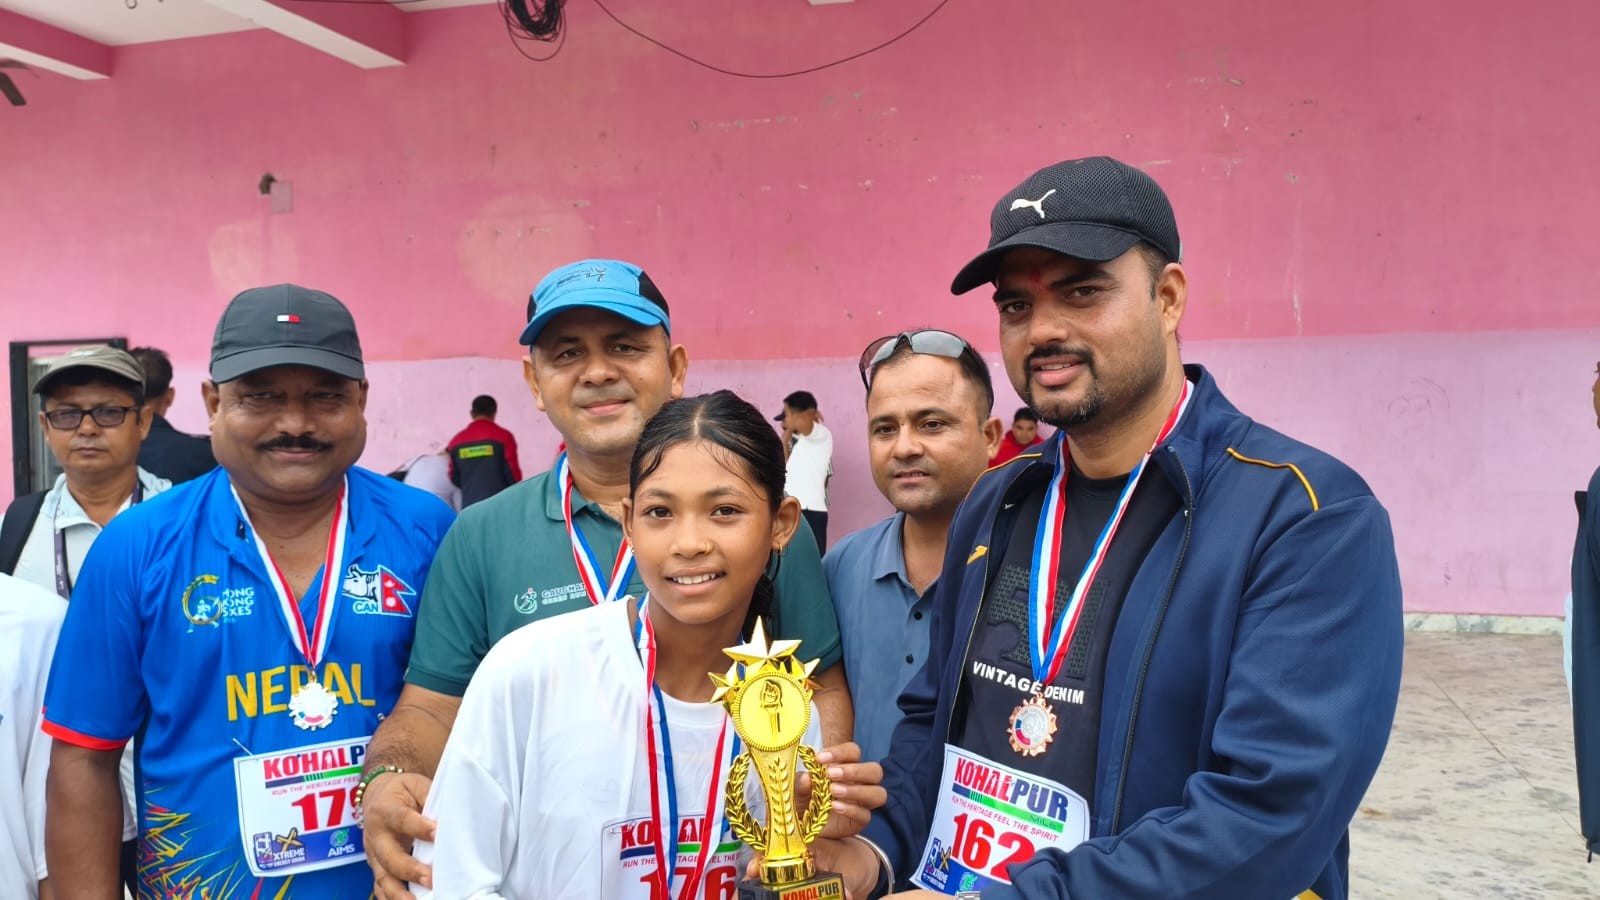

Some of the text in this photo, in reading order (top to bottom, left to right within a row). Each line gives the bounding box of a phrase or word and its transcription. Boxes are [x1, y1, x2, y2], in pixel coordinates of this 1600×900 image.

[222, 597, 254, 607] KONG
[354, 601, 379, 613] CAN
[972, 661, 1085, 705] VINTAGE DENIM
[263, 744, 369, 780] KOHALP
[290, 785, 303, 793] THE
[954, 757, 1068, 822] KOHALPUR
[967, 802, 992, 818] HERITAGE
[993, 812, 1010, 826] FEEL
[1013, 821, 1028, 833] THE
[1030, 827, 1059, 842] SPIRIT
[273, 847, 305, 861] XTREME
[328, 843, 355, 857] AIMS
[951, 813, 1035, 885] 162
[622, 859, 638, 868] RUN
[640, 858, 657, 866] THE
